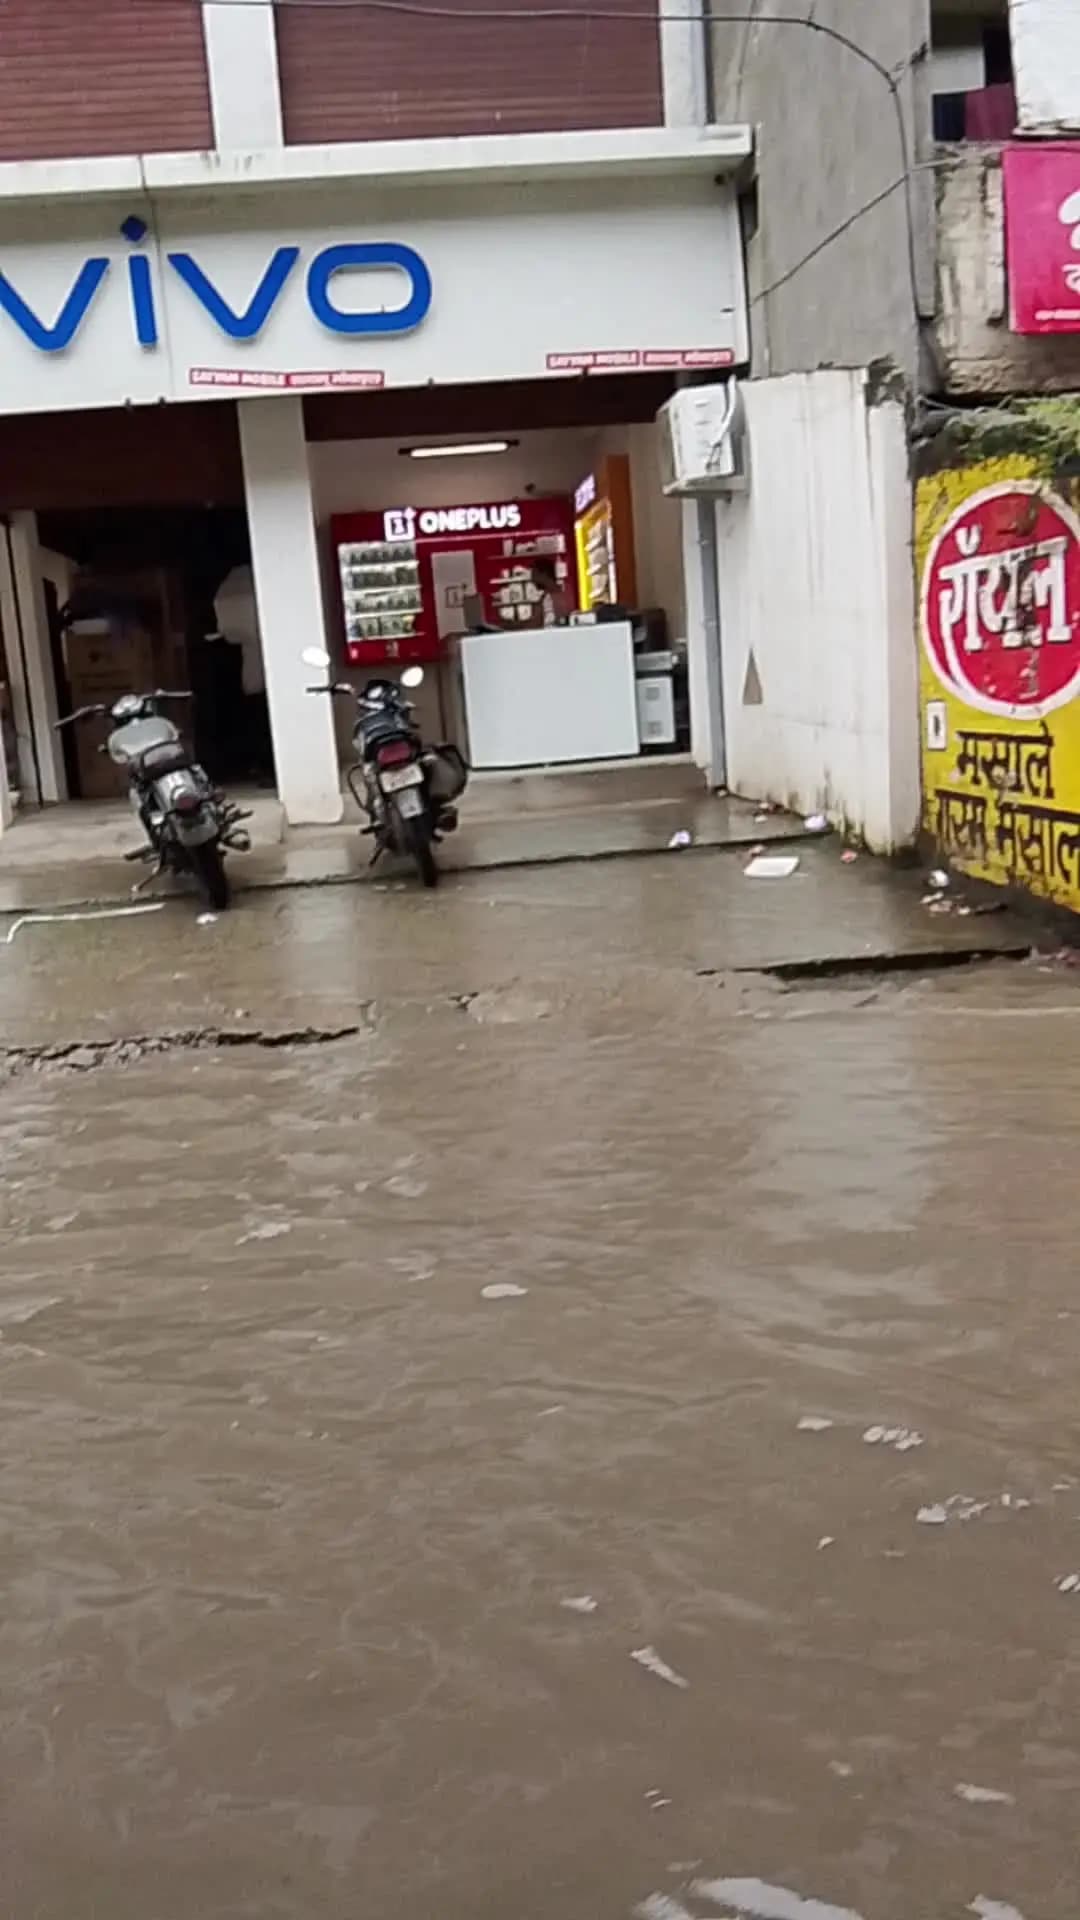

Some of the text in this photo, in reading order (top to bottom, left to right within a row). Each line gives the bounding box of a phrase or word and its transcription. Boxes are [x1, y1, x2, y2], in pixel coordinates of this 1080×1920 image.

[0, 215, 432, 351] vivo
[419, 504, 521, 534] ONEPLUS
[956, 720, 1055, 800] मसाले
